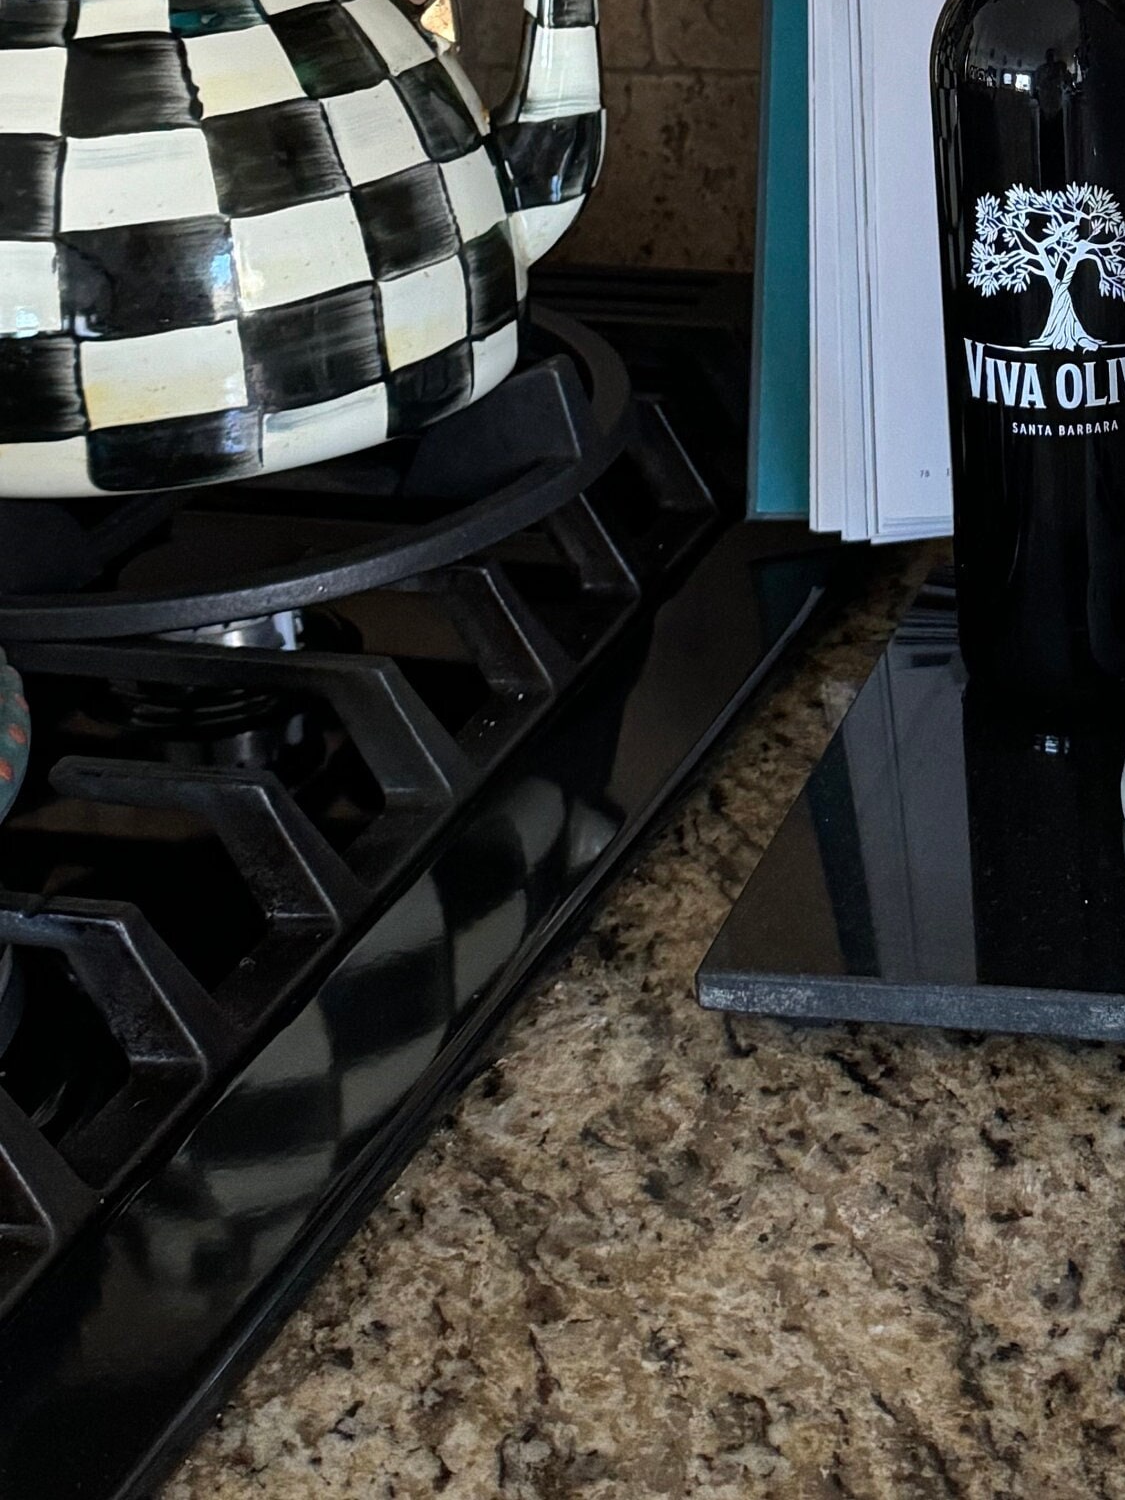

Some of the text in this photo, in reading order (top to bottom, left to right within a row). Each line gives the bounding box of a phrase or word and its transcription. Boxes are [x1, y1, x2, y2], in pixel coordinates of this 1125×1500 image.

[964, 337, 1047, 410] VIVA
[1012, 418, 1119, 437] SANTA BARBARA
